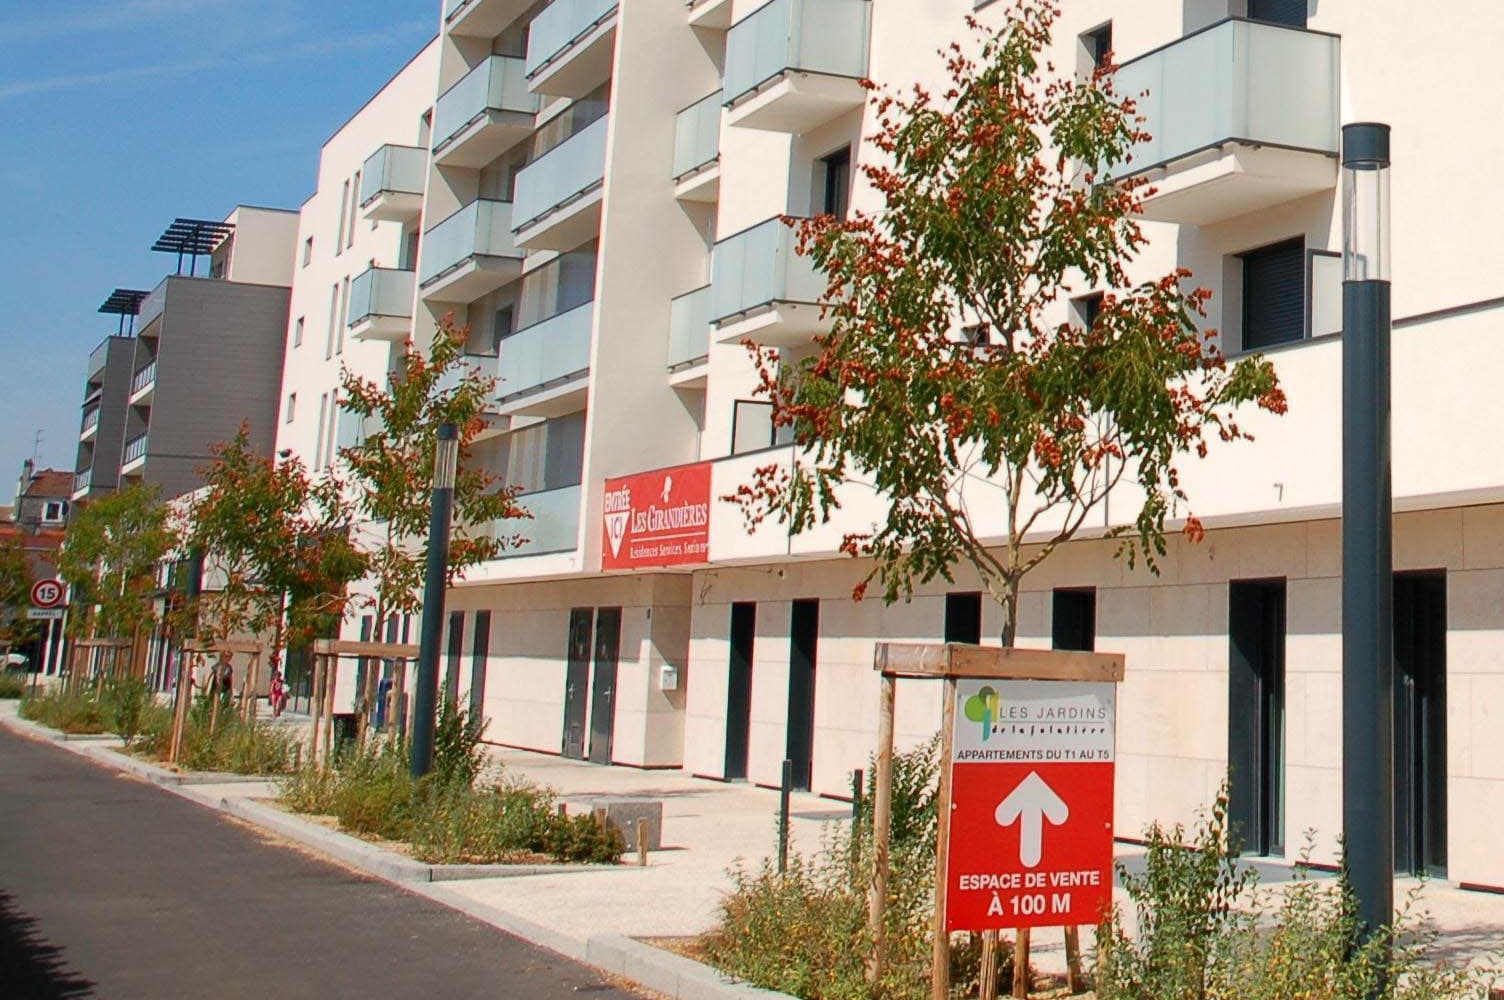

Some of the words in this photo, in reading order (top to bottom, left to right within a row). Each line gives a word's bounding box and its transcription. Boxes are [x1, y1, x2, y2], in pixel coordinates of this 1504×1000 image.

[610, 516, 622, 539] ICI
[40, 588, 56, 600] 15
[1000, 707, 1028, 719] LES
[1037, 707, 1106, 719] JARDINS
[957, 750, 1043, 760] APPARTEMENTS
[1046, 750, 1062, 760] DU
[1065, 750, 1076, 760] T1
[1079, 750, 1094, 760] AU
[1098, 750, 1110, 760] T5
[959, 873, 1021, 891] ESPACE
[1025, 872, 1047, 888] DE
[1049, 870, 1100, 887] VENTE
[987, 890, 1004, 916] À
[1009, 893, 1046, 916] 100
[1051, 893, 1071, 914] M
